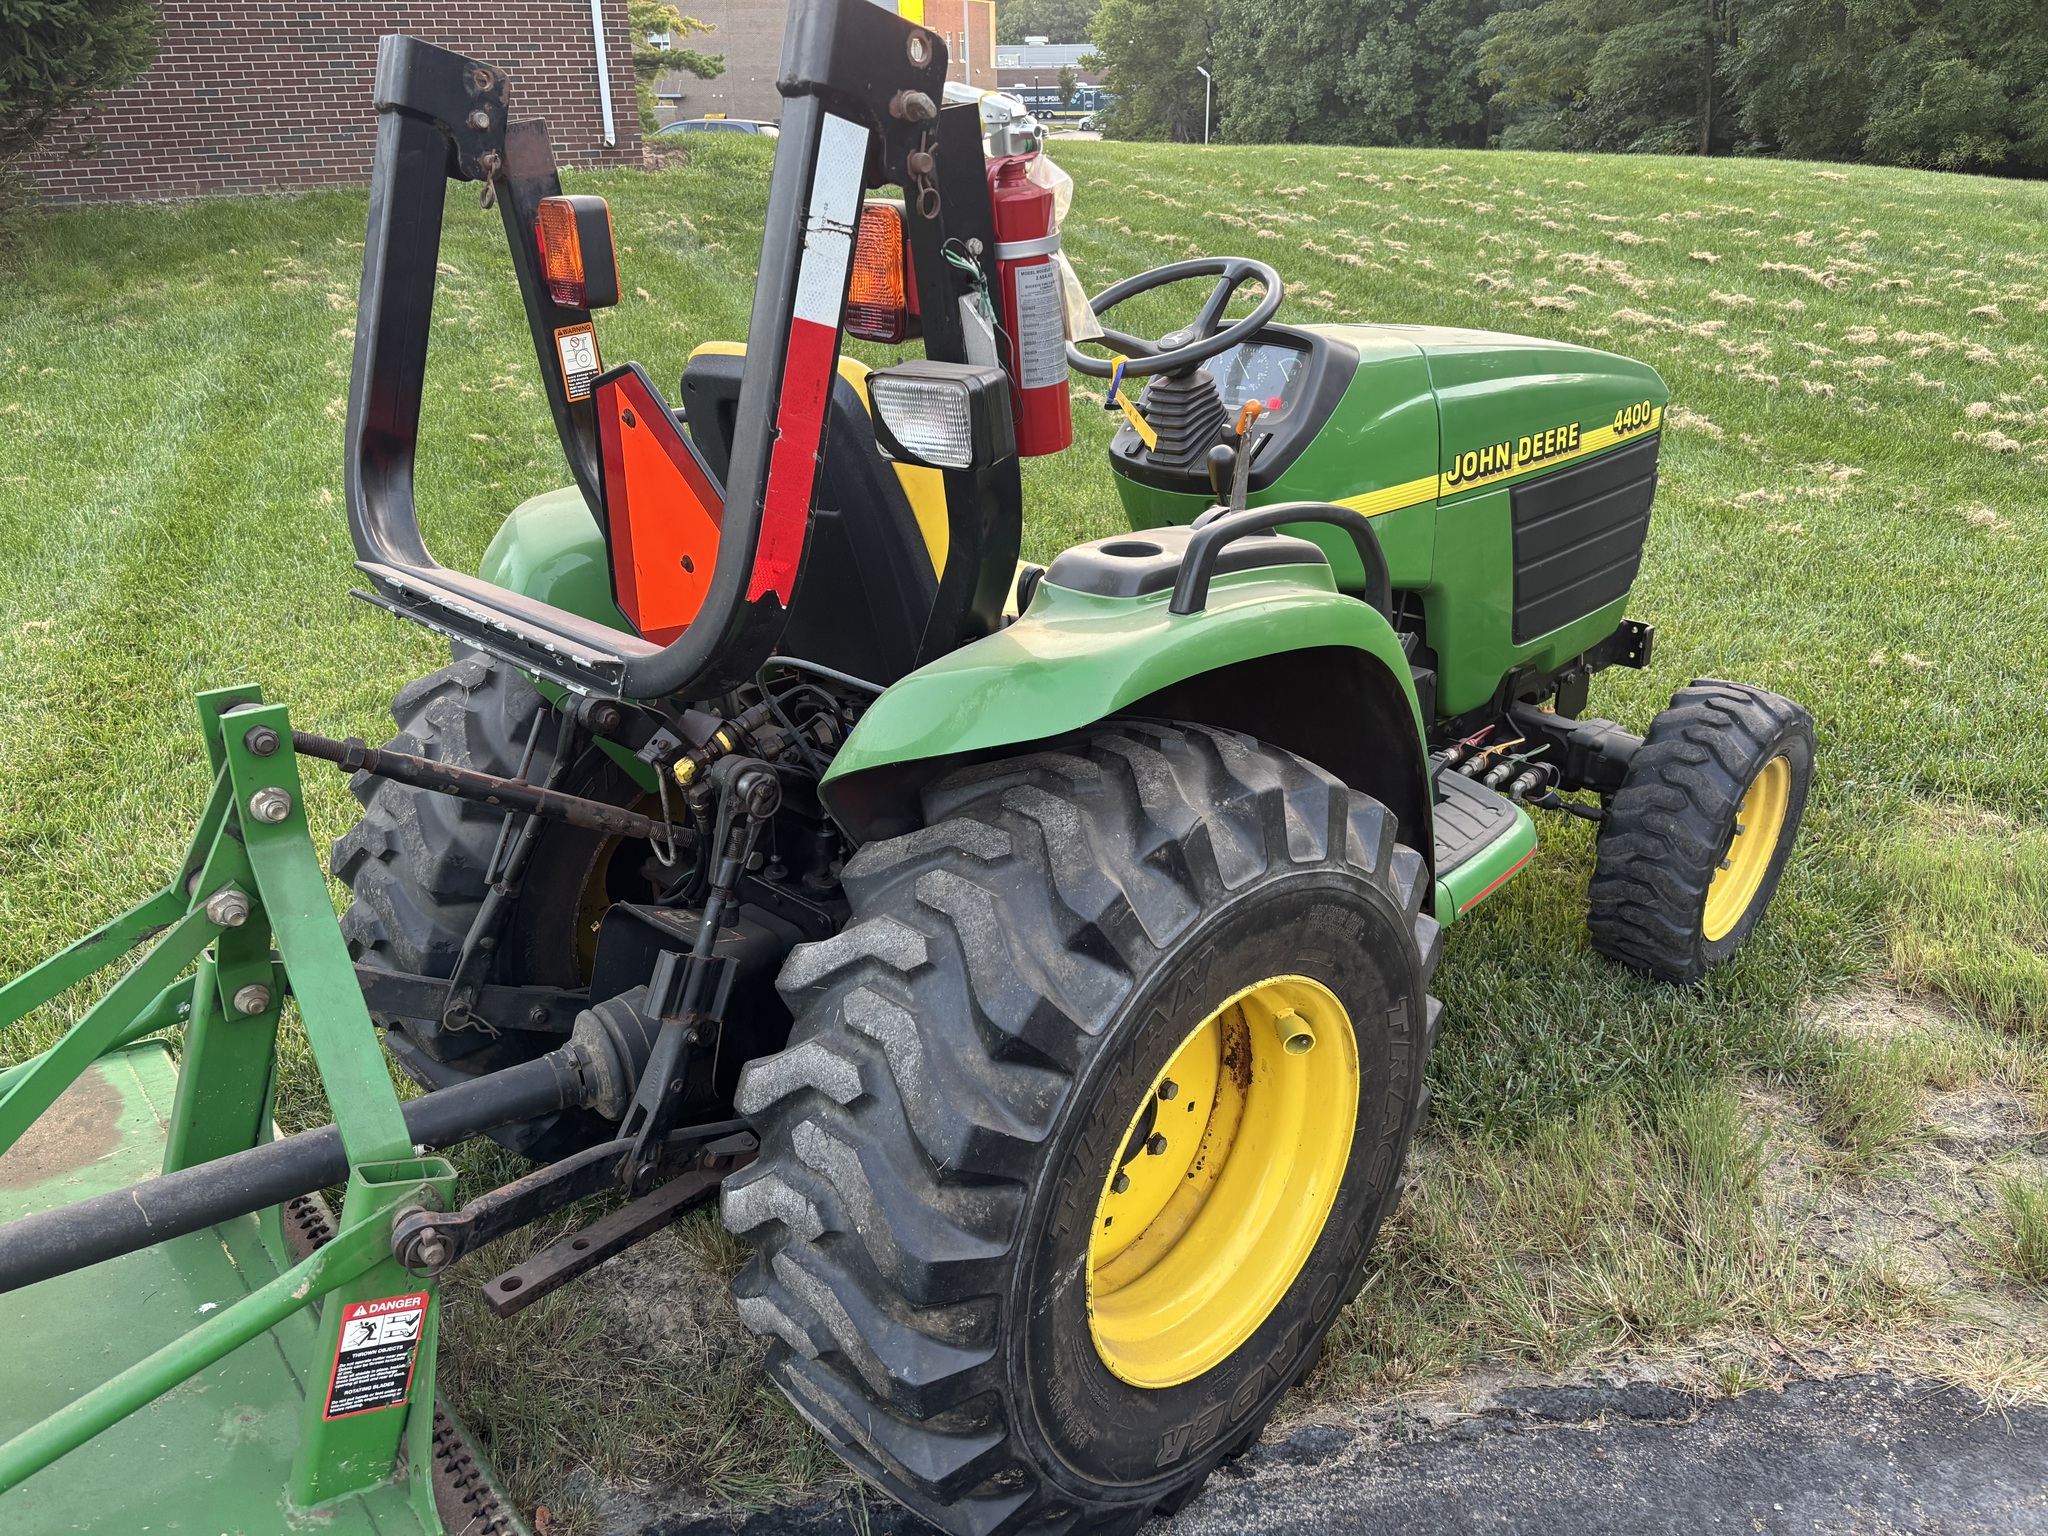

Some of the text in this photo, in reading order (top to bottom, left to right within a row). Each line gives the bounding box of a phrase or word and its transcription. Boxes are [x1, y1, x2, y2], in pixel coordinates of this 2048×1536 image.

[563, 324, 591, 335] WARNING
[1613, 400, 1651, 435] 4400
[1447, 421, 1580, 486] JOHN DEERE
[1367, 996, 1411, 1195] TRAC
[369, 1297, 422, 1314] DANGER
[352, 1345, 403, 1358] THROWN OBJECTS
[1156, 1221, 1364, 1468] LOADER
[344, 1386, 371, 1395] ROTATING
